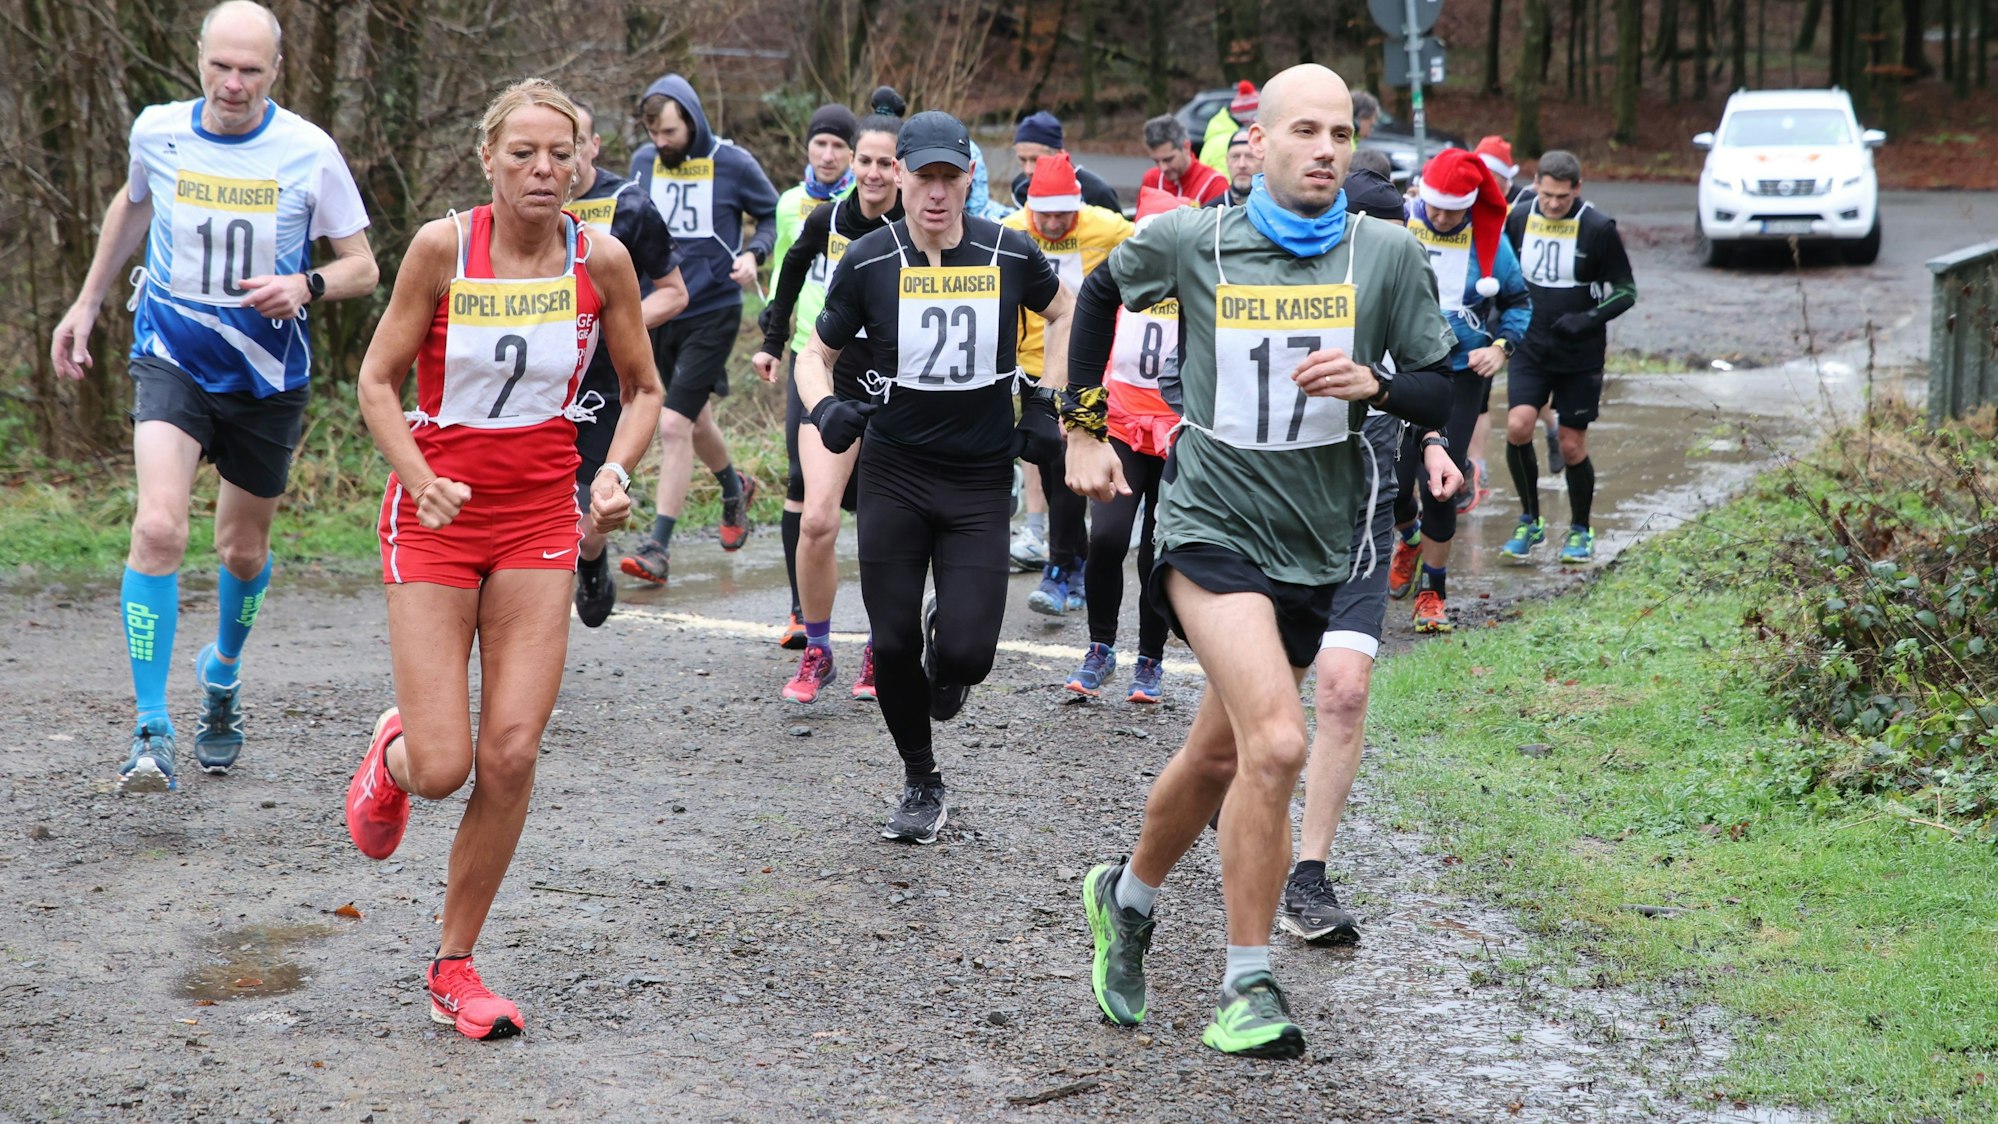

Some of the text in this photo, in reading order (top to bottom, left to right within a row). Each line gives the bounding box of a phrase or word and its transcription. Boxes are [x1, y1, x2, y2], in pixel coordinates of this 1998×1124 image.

[177, 179, 275, 206] OPEL KAISER
[666, 182, 699, 232] 25
[196, 217, 254, 297] 10
[831, 240, 845, 255] OP
[1533, 239, 1560, 283] 20
[454, 289, 571, 317] OPEL KAISER
[903, 274, 996, 293] OPEL KAISER
[1150, 302, 1178, 315] KAIS
[1222, 295, 1349, 320] OPEL KAISER
[918, 305, 977, 384] 23
[1139, 322, 1163, 380] 8
[487, 334, 528, 419] 2
[1250, 336, 1321, 443] 17
[126, 601, 160, 640] cep
